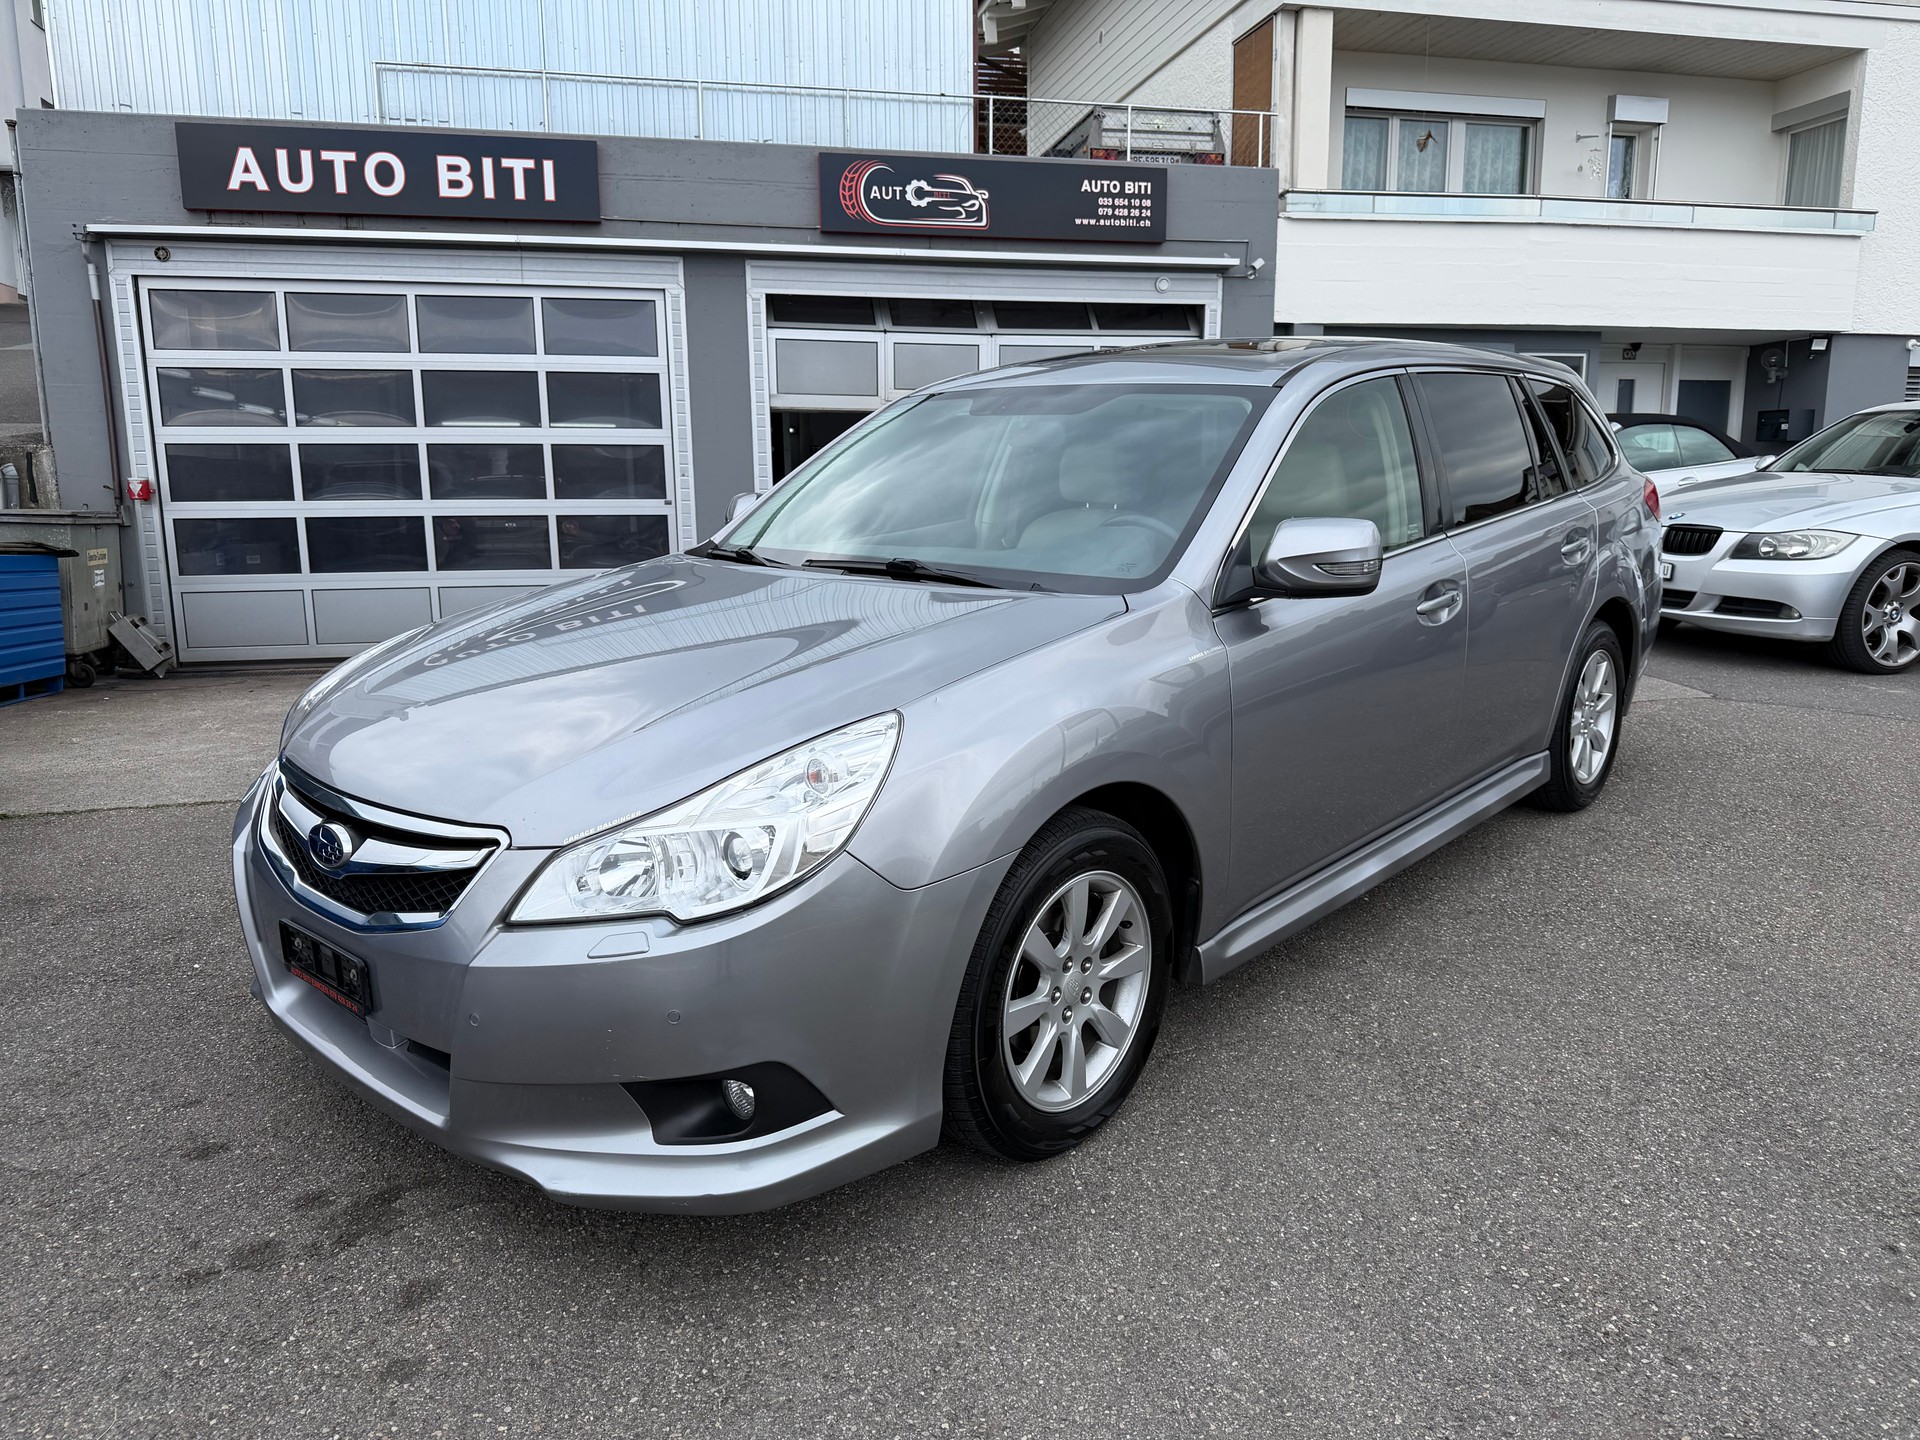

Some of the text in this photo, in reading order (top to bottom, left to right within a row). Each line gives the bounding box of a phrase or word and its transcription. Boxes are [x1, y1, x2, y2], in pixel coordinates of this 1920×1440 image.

[226, 147, 556, 202] AUTO BITI
[1081, 179, 1152, 195] AUTO BITI
[1098, 197, 1152, 207] 033 654 10 08
[1098, 207, 1113, 216] 079
[1114, 208, 1129, 217] 428
[1141, 209, 1151, 217] 24
[1075, 218, 1151, 228] www.autobiti.ch
